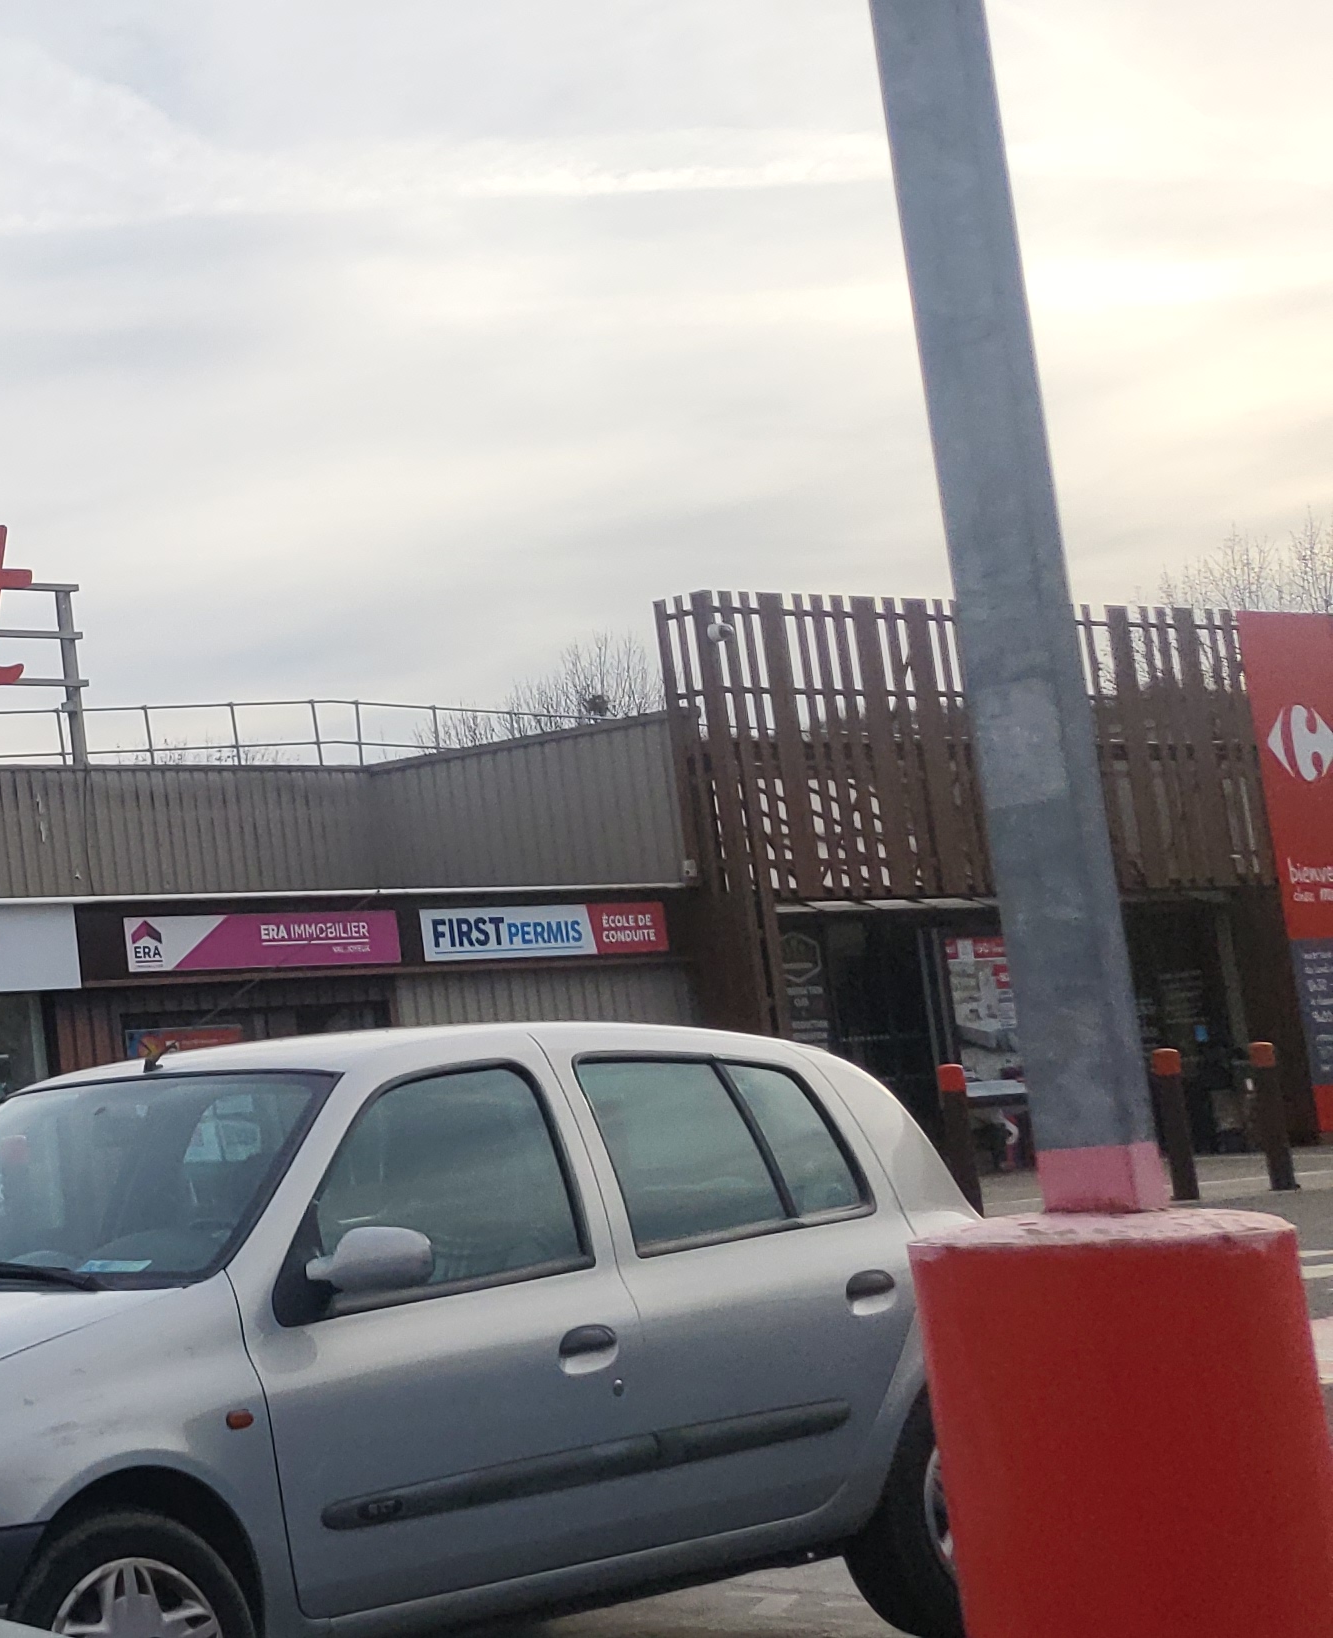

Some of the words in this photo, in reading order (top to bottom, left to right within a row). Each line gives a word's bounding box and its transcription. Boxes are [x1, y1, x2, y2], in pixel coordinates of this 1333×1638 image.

[601, 912, 635, 928] ÉCOLE
[638, 913, 653, 926] DE
[260, 923, 288, 940] ERA
[290, 922, 370, 938] IMMOBILIER
[602, 929, 657, 944] CONDUITE
[133, 945, 163, 959] ERA
